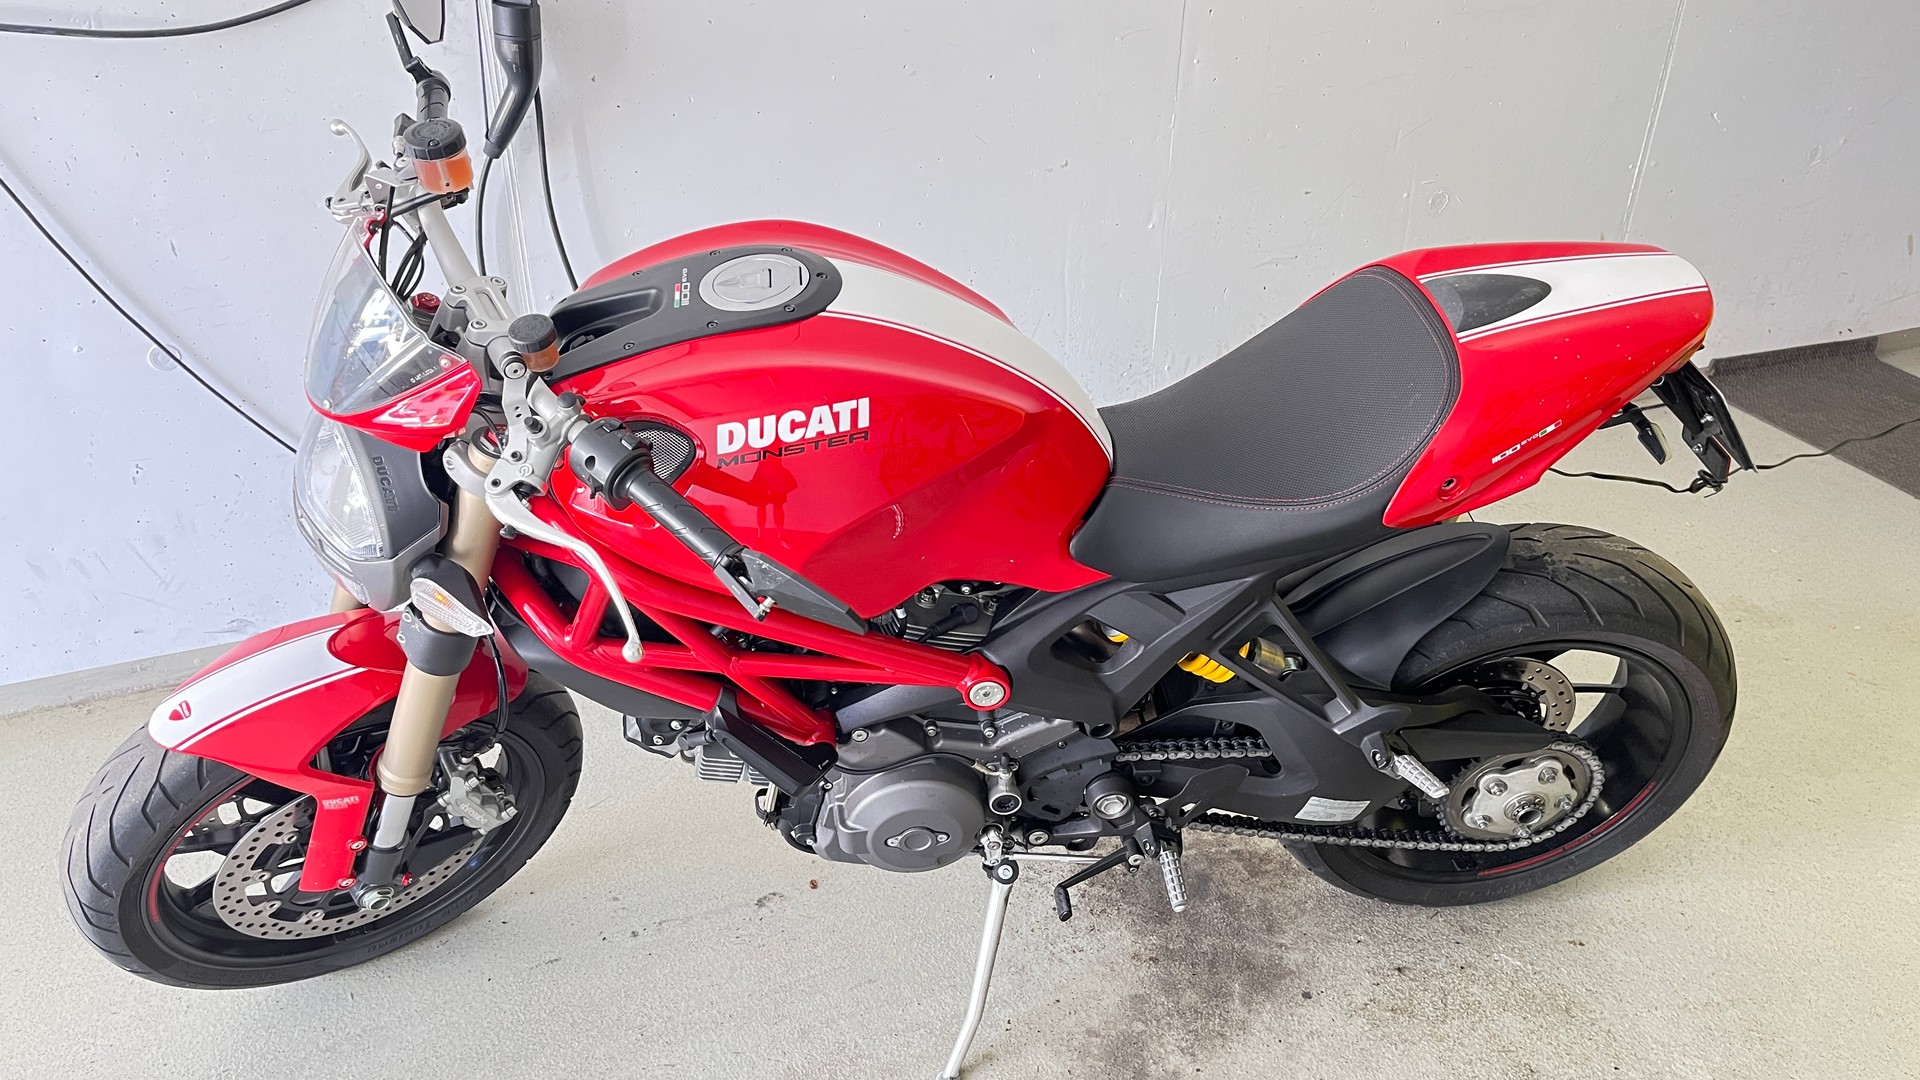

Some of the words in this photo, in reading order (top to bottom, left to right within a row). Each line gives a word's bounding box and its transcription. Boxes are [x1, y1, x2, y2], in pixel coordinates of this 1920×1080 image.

[717, 397, 870, 455] DUCATI
[717, 431, 870, 469] MONSTER
[372, 456, 399, 512] DUCATI
[322, 795, 359, 806] DUCATI
